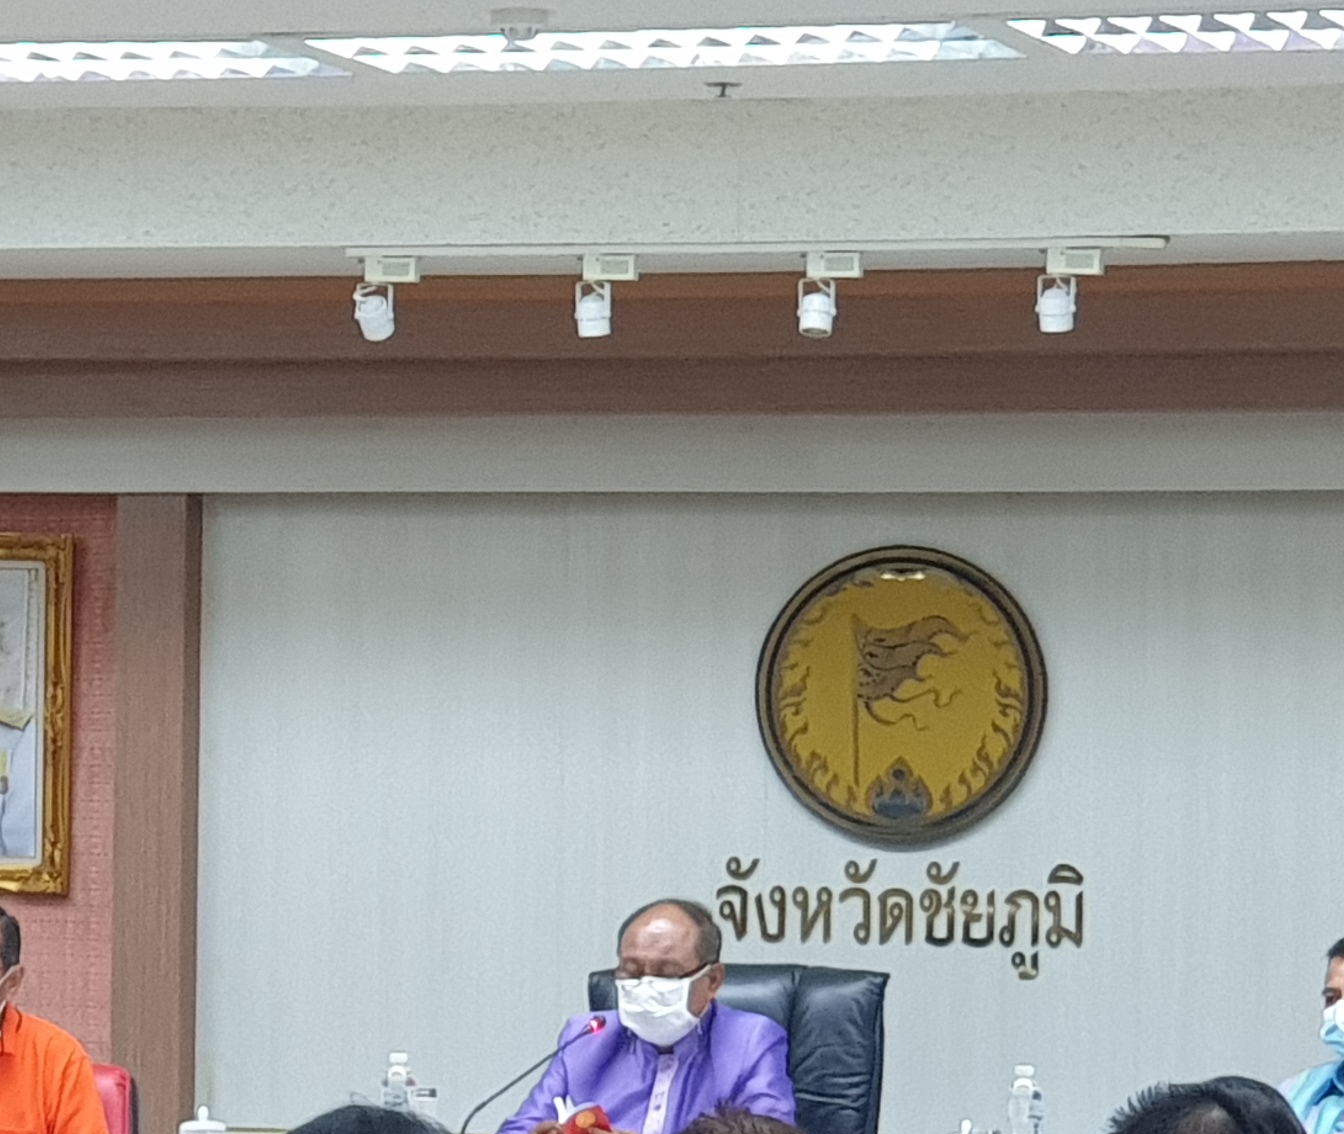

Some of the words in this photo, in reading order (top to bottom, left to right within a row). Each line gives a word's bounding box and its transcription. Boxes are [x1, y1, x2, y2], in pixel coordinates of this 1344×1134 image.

[715, 855, 1085, 981] จังหวัดชัยภูมิ
